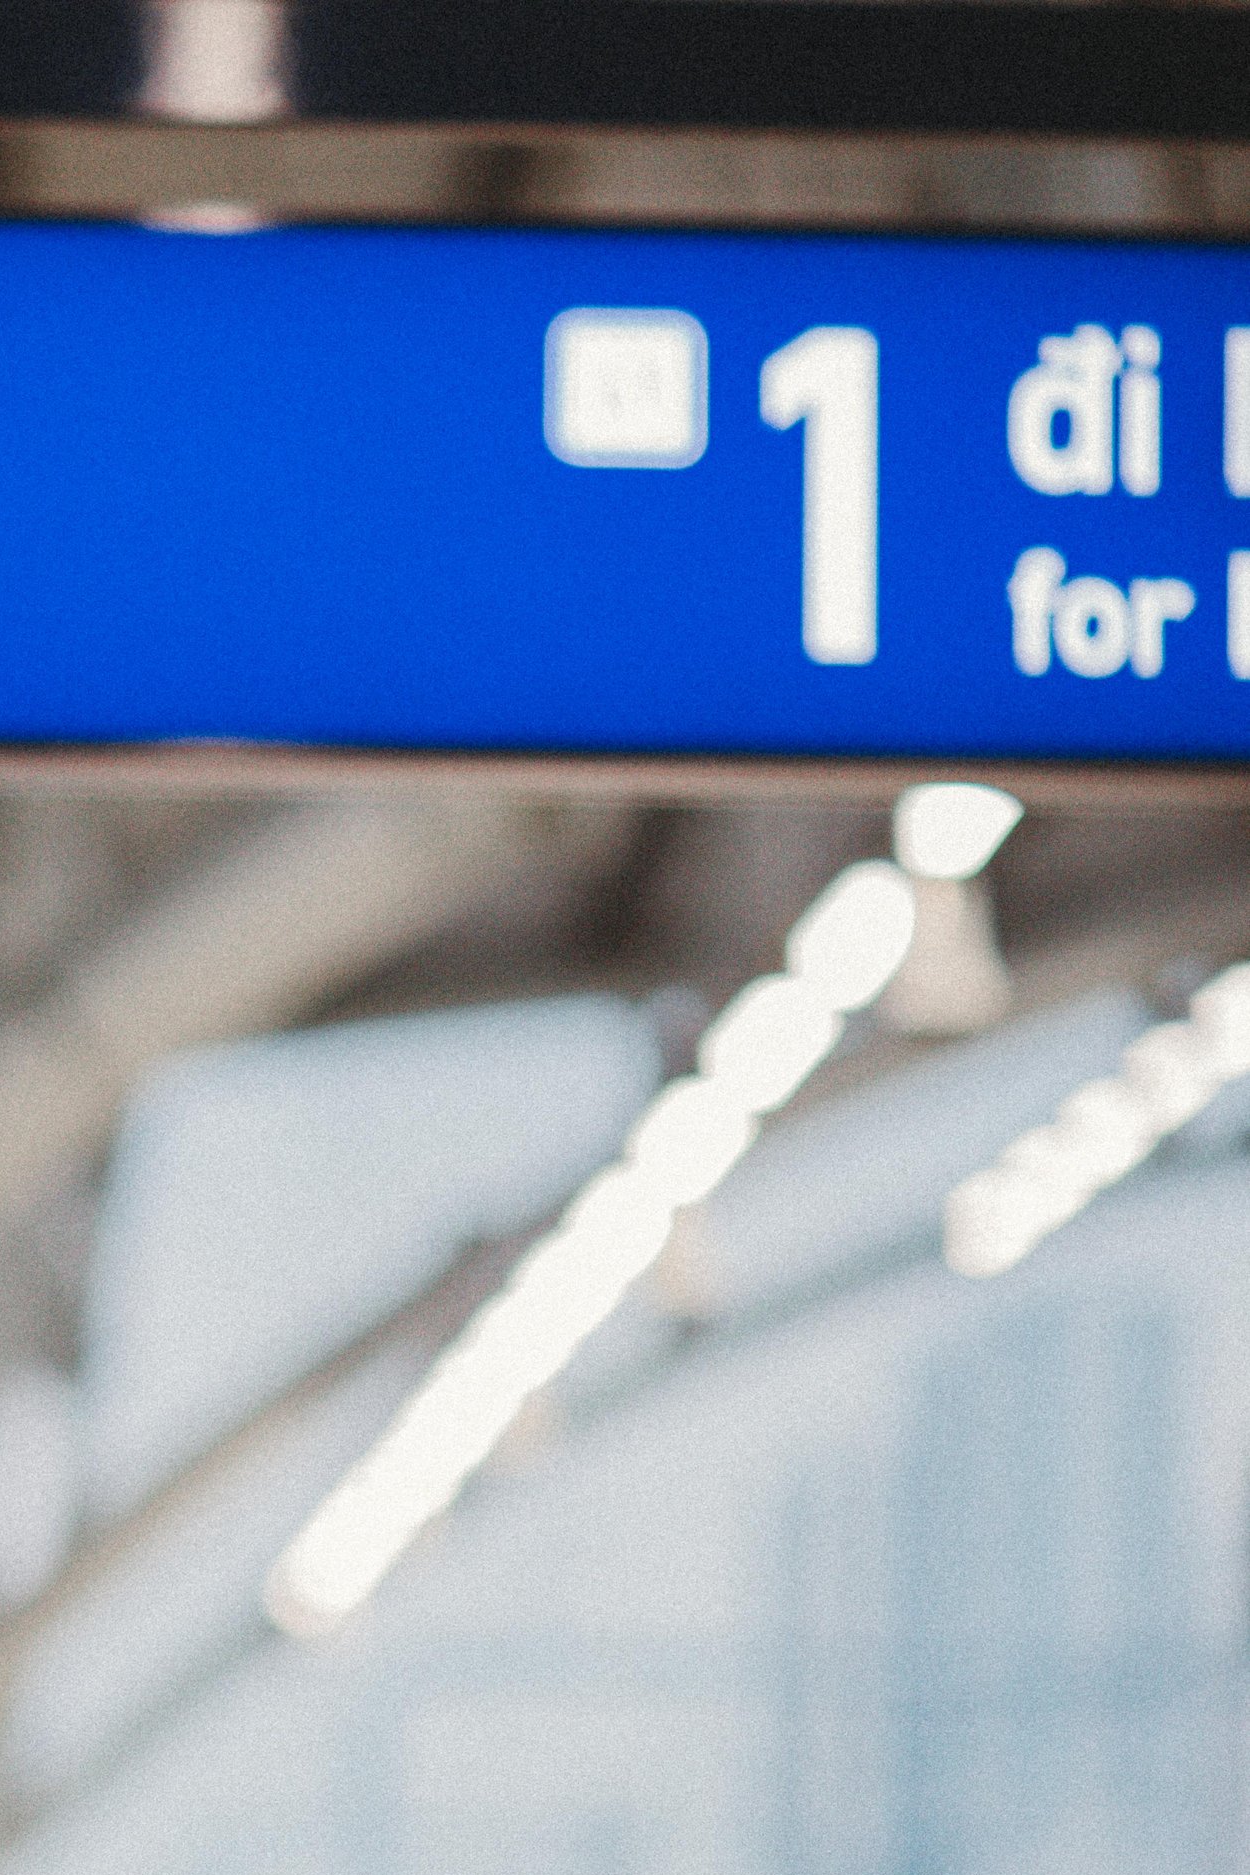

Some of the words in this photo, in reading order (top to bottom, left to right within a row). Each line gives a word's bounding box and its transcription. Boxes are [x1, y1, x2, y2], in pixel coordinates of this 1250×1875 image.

[760, 326, 879, 665] 1
[1007, 323, 1161, 496] đi
[1007, 547, 1195, 678] for
